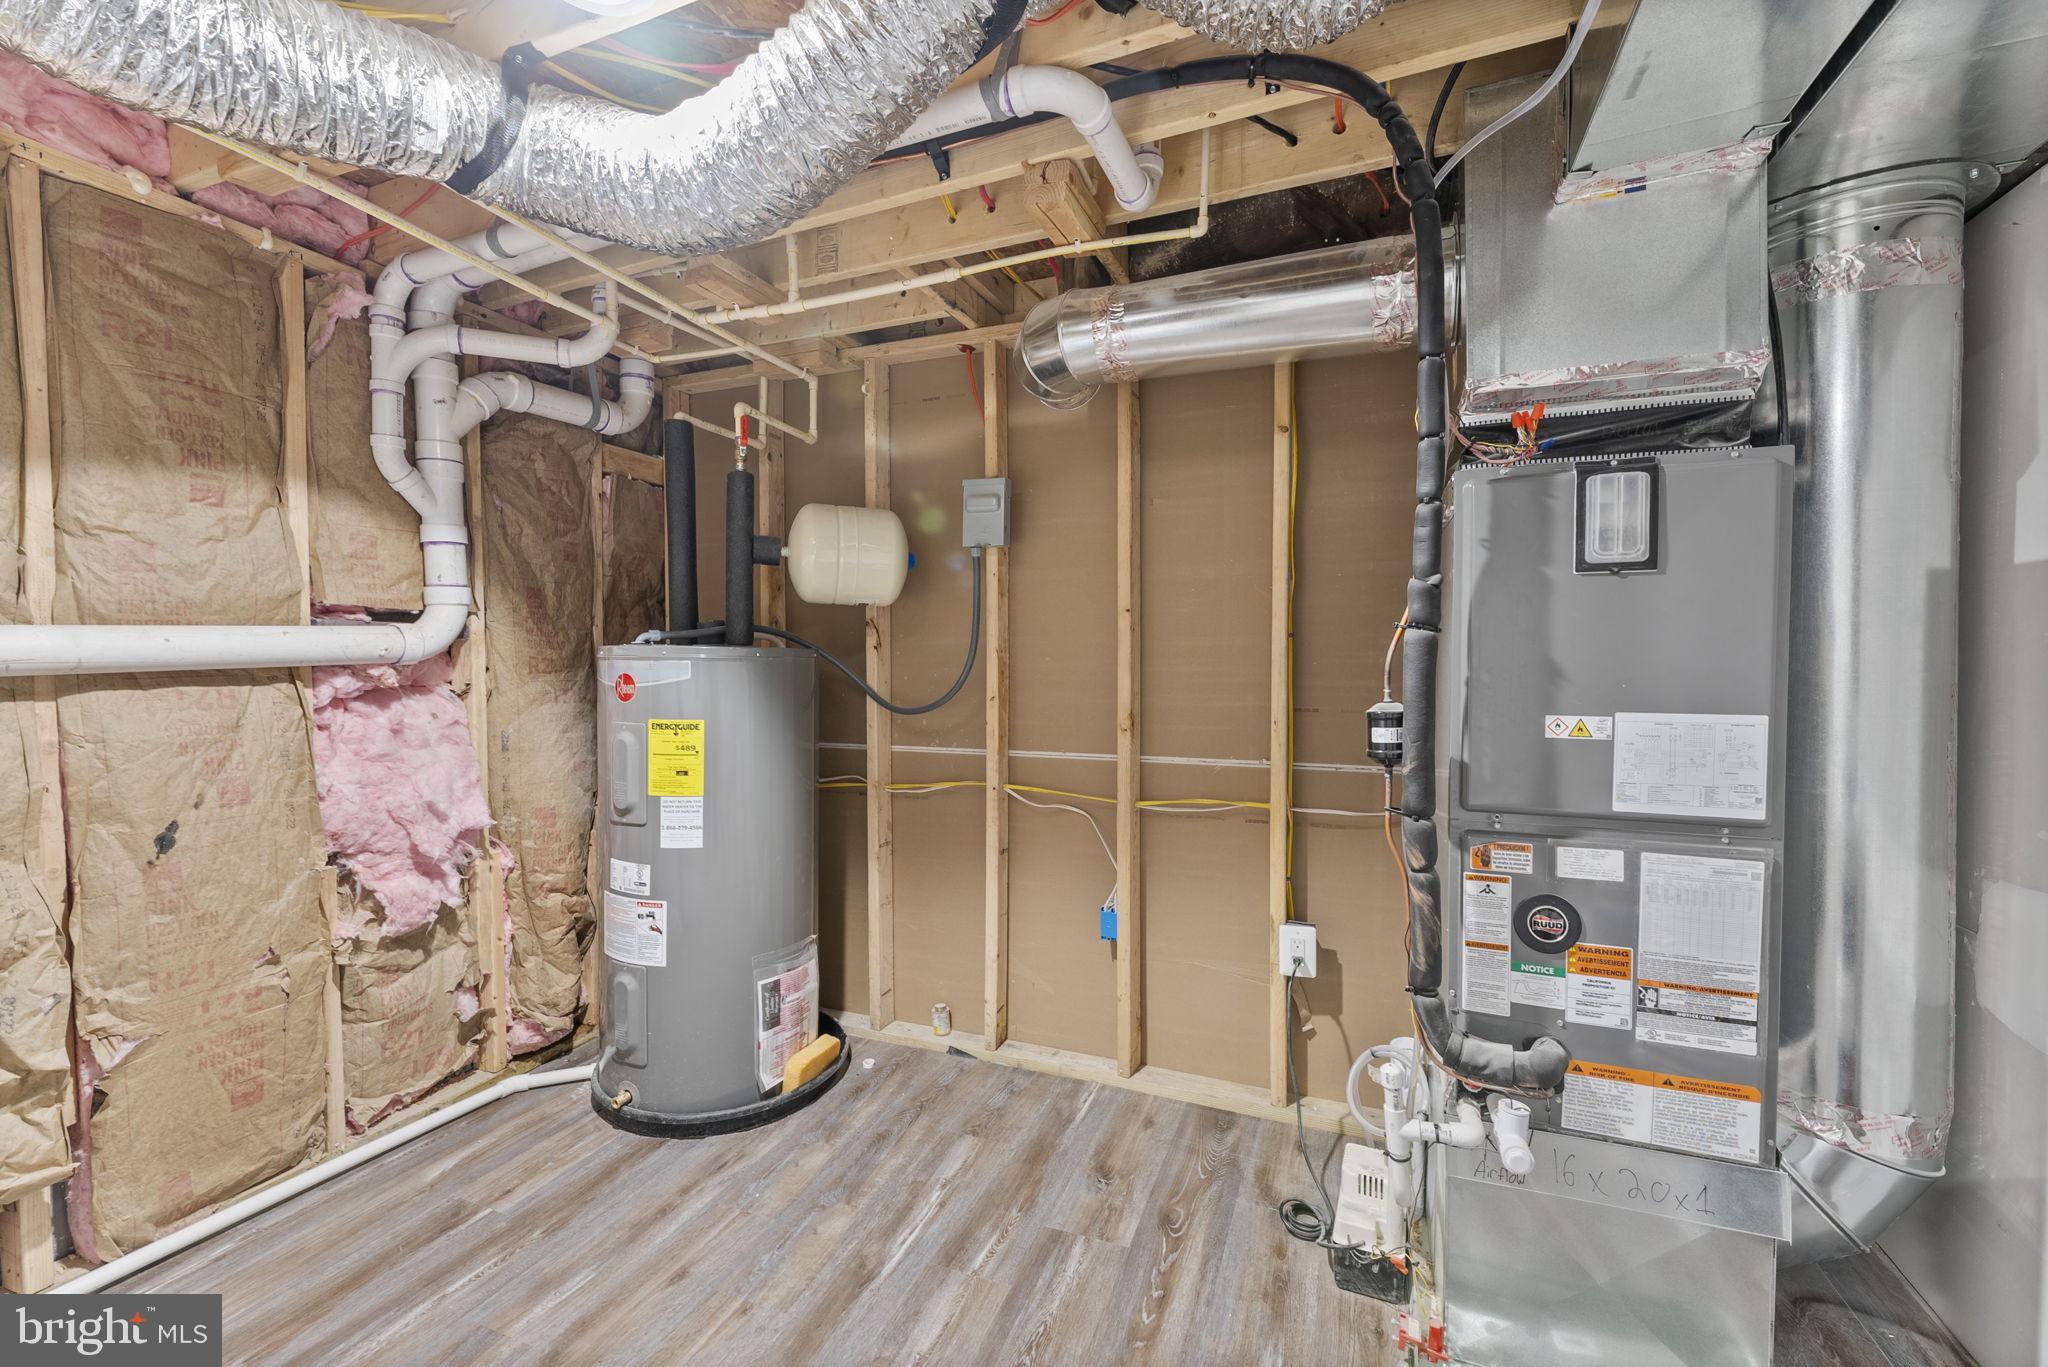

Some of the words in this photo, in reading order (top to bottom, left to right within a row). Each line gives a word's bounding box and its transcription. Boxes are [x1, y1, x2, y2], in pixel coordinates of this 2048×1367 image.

[1473, 874, 1507, 884] WARNING
[1533, 919, 1563, 929] RUUD
[1578, 946, 1629, 957] WARNING
[1577, 956, 1629, 967] AVERTISSEMENT
[1520, 964, 1555, 975] NOTICE
[1579, 966, 1627, 977] ADVERTENCIA
[1591, 1066, 1626, 1076] WARNING
[1589, 1071, 1606, 1079] RISK
[1618, 1075, 1635, 1083] FIRE
[1678, 1084, 1708, 1095] RISQUE
[1680, 1080, 1742, 1093] AVERTISSEMENT
[1473, 1159, 1527, 1186] Airflow
[1553, 1148, 1576, 1187] 16
